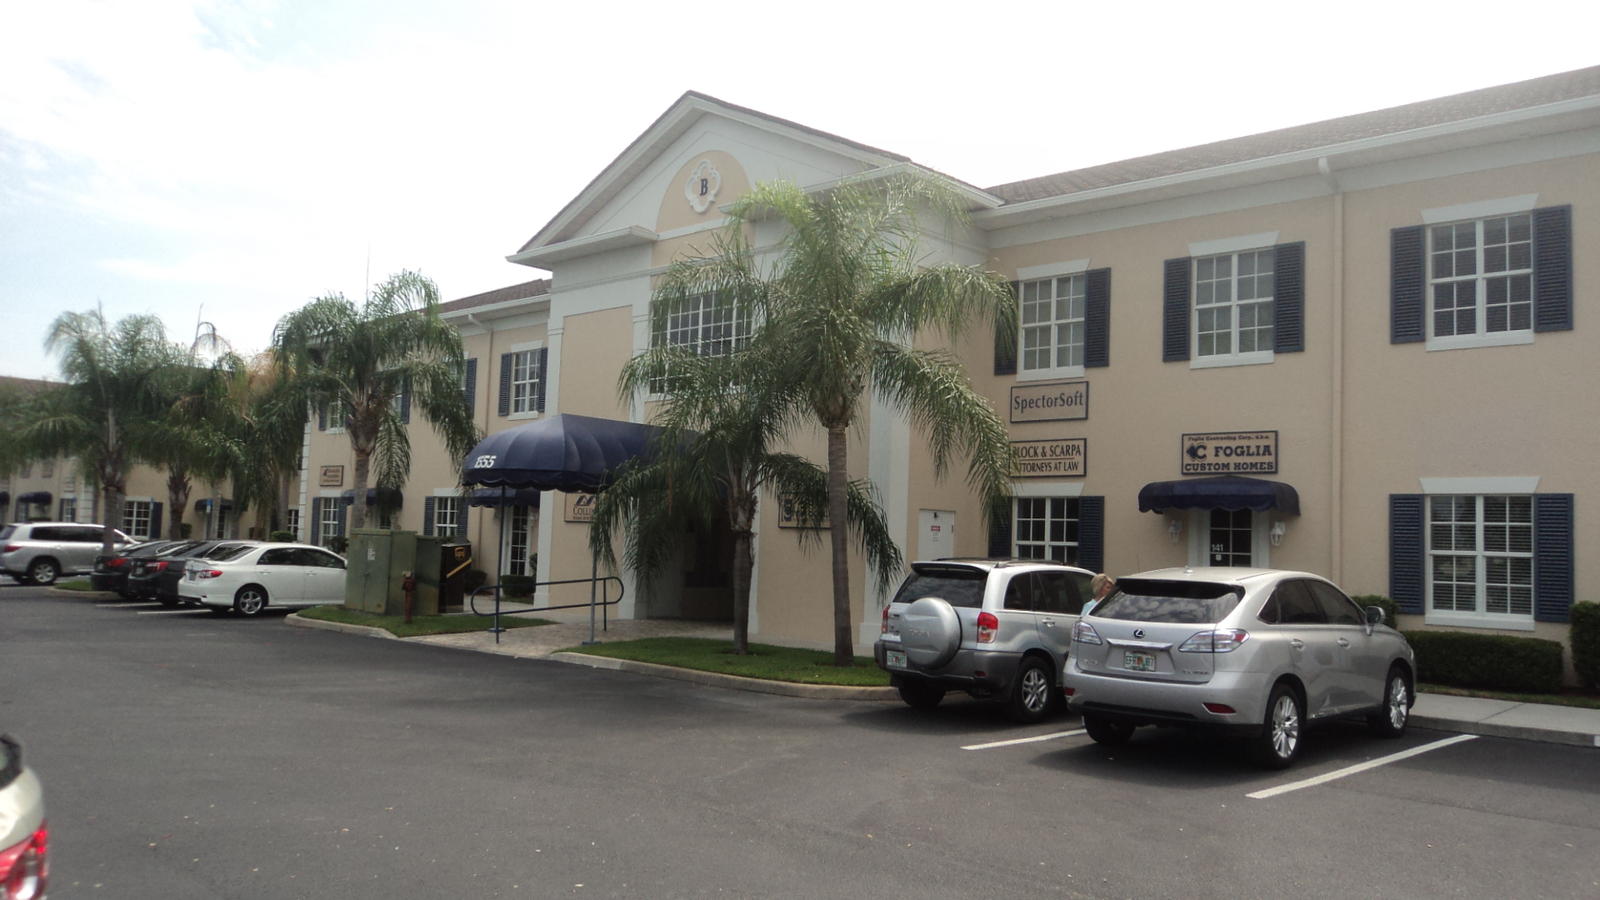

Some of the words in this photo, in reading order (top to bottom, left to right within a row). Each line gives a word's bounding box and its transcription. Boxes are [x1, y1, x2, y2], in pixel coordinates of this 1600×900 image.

[700, 178, 709, 197] B
[1014, 391, 1083, 413] SpectorSoft
[1041, 446, 1048, 458] &
[1049, 444, 1081, 457] SCARPA
[1214, 445, 1272, 457] FOGLIA
[1013, 462, 1053, 473] TTORNEYS
[1054, 461, 1062, 472] AT
[1063, 461, 1079, 471] LAW
[1184, 463, 1230, 471] CUSTOM
[1233, 462, 1274, 471] HOMES
